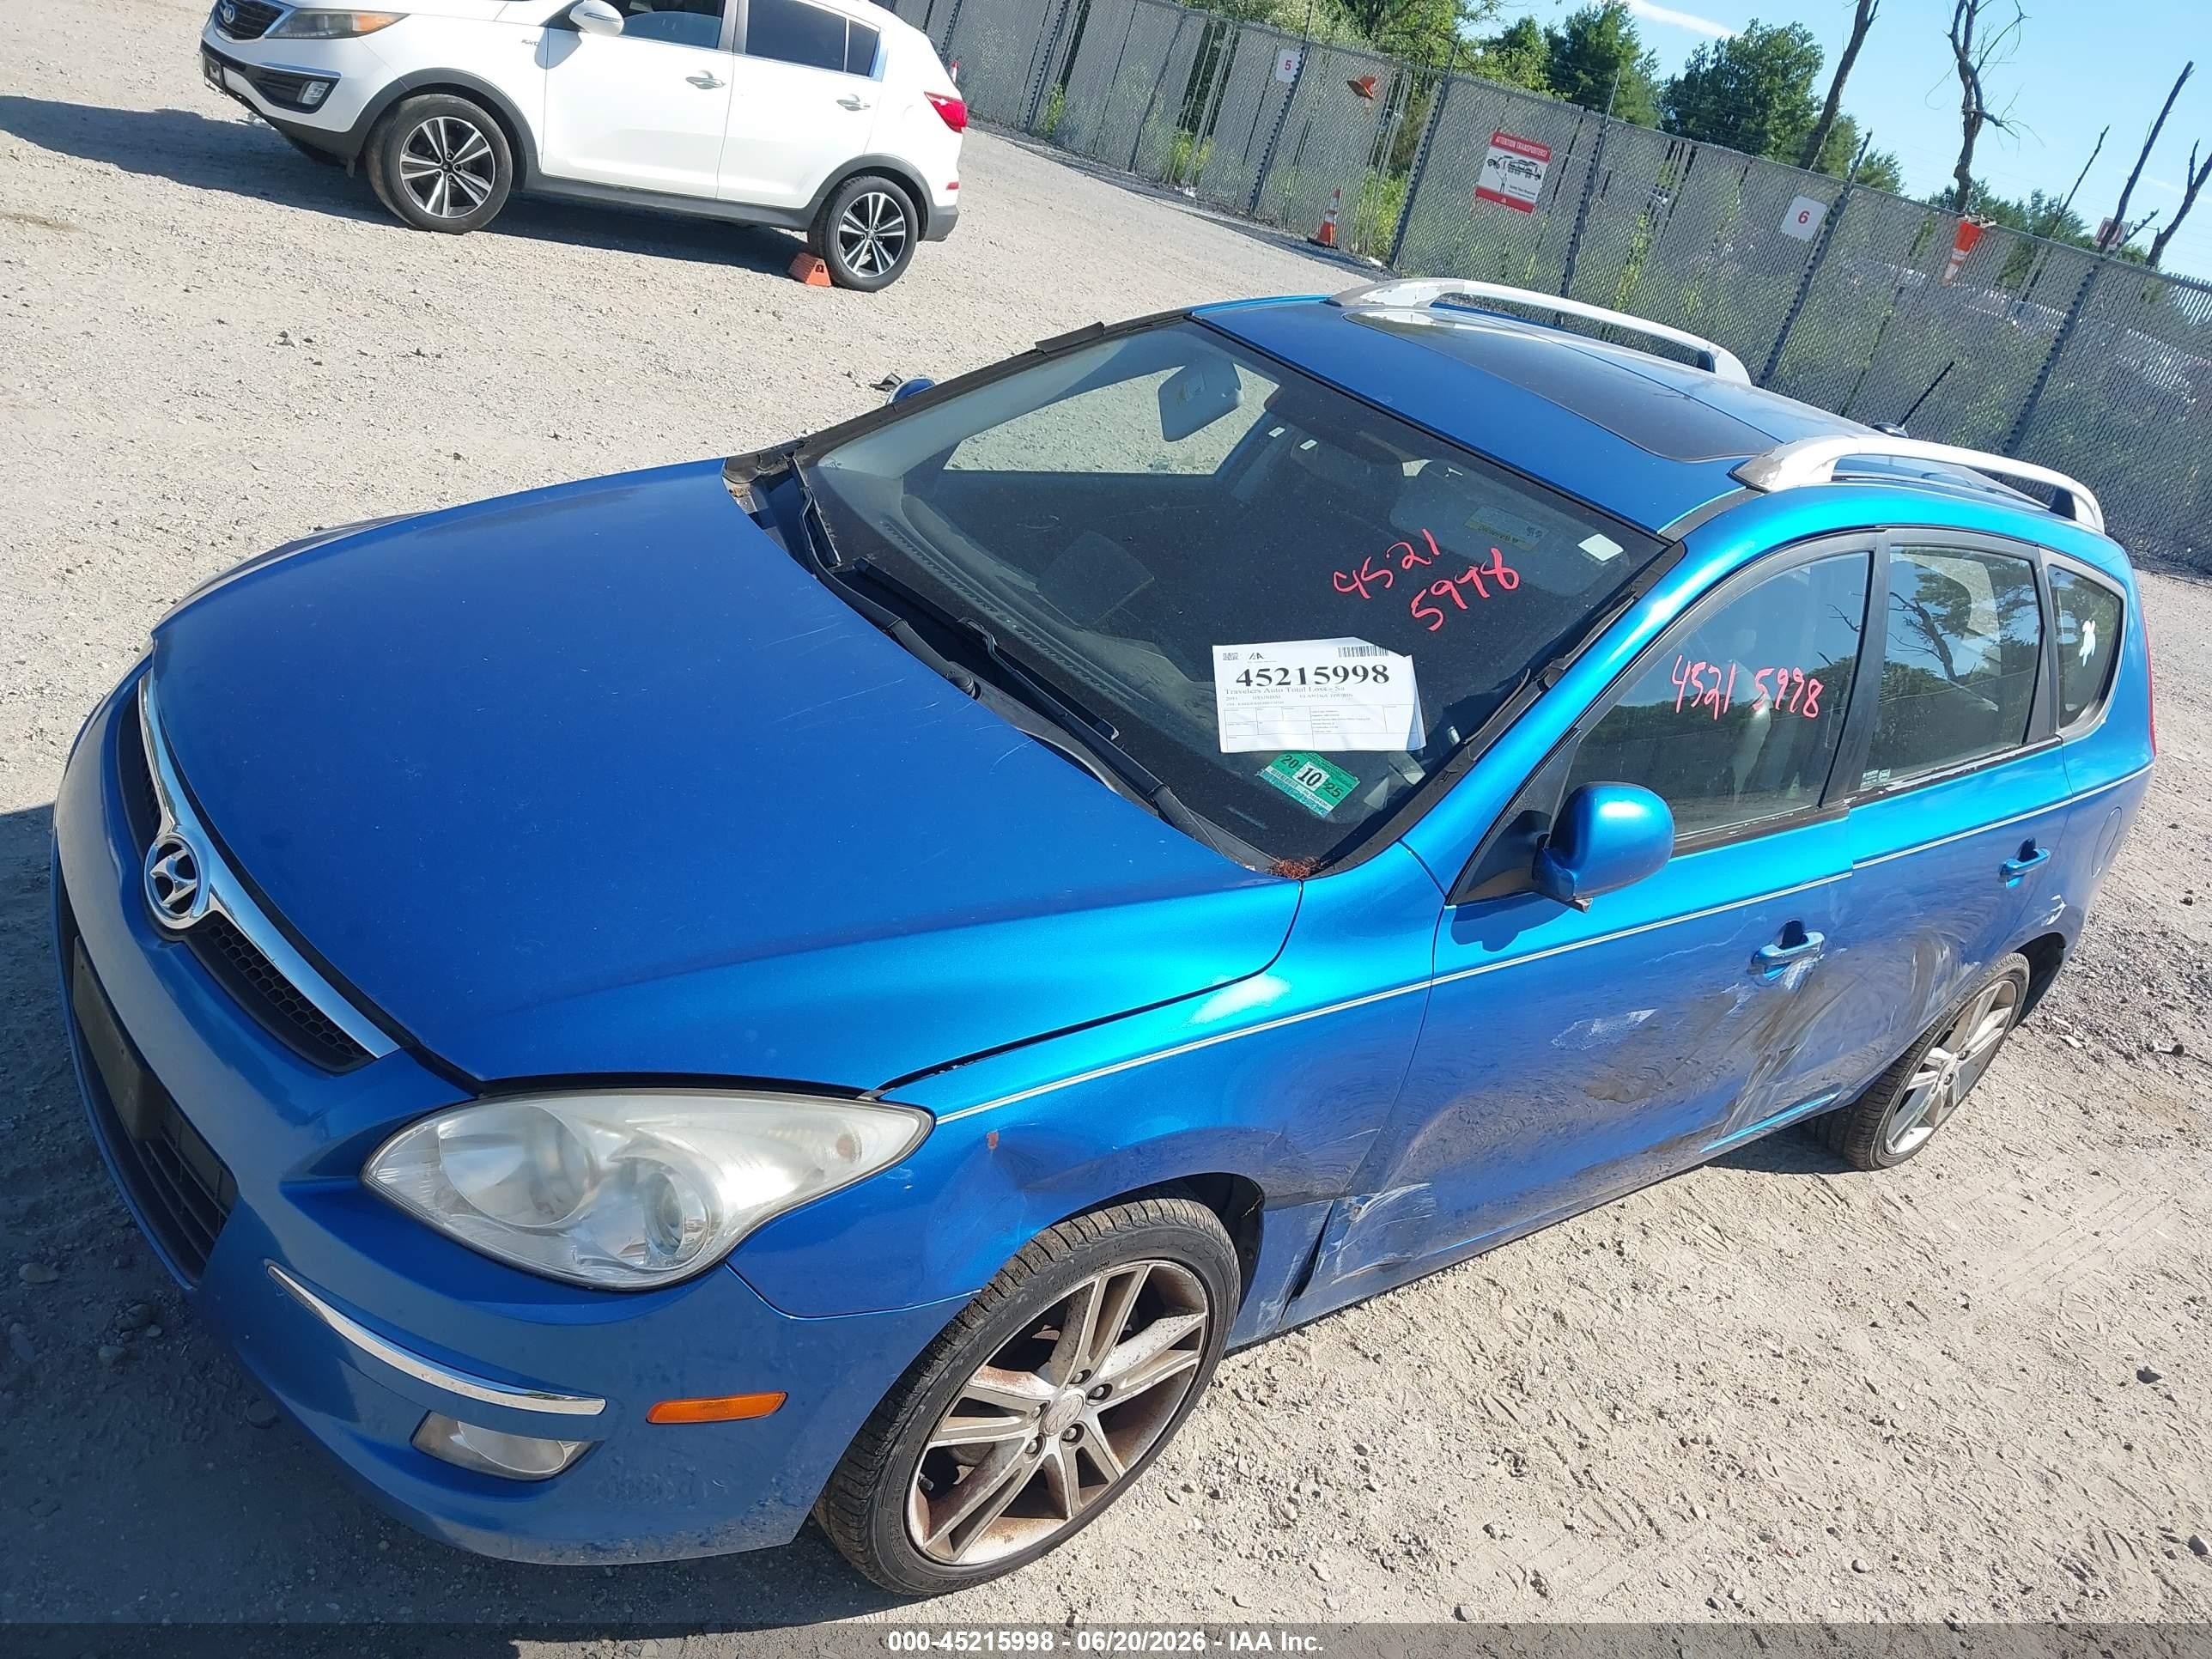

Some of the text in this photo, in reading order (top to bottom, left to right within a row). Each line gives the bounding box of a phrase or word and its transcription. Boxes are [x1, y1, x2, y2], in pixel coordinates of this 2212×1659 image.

[1285, 59, 1292, 70] 5
[1798, 210, 1810, 224] 6
[1333, 527, 1441, 599] 4521
[1236, 664, 1390, 687] 45215998
[1671, 653, 1825, 721] 4521 5998
[1297, 768, 1322, 787] 10
[1324, 782, 1342, 799] 25
